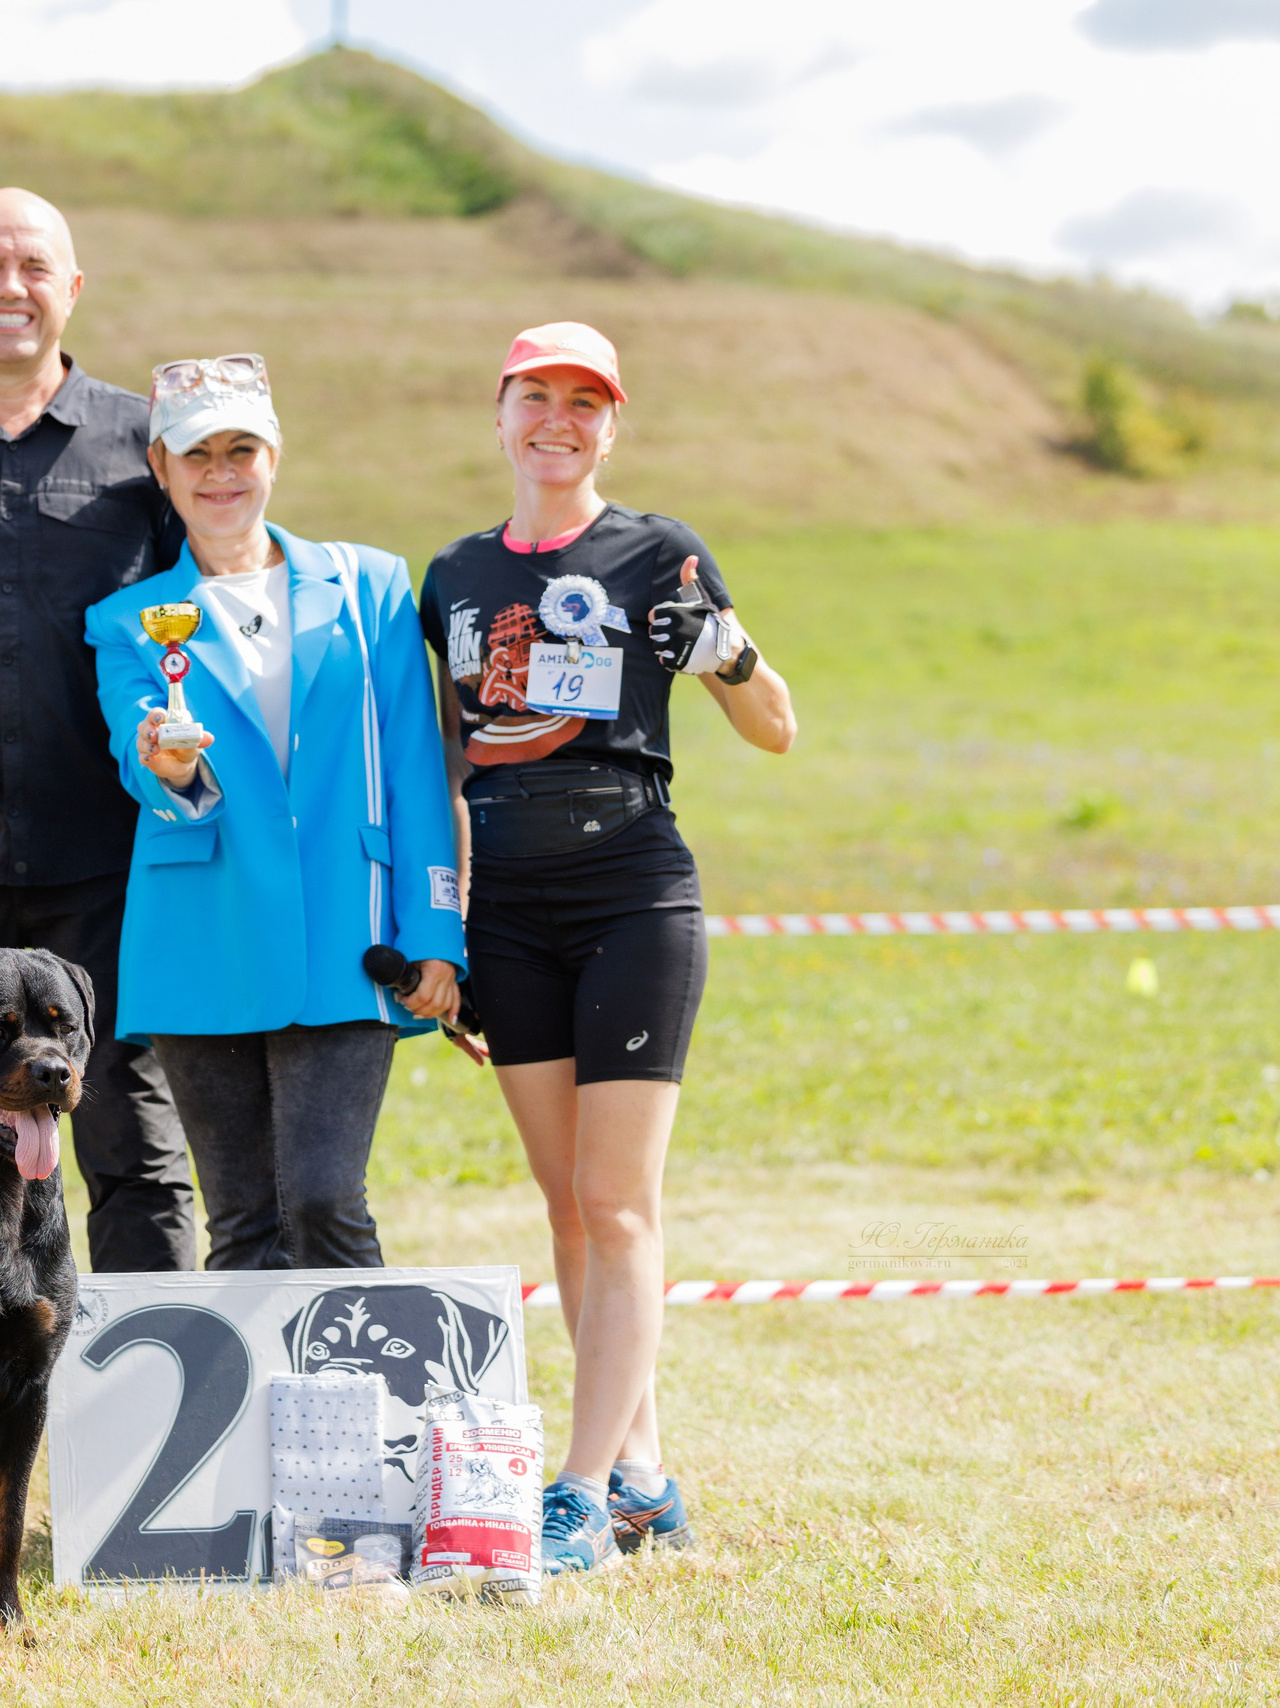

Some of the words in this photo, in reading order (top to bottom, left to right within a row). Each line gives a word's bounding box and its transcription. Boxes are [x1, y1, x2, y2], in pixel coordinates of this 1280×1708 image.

[449, 607, 481, 639] WE
[447, 631, 482, 669] RUN
[552, 671, 584, 702] 19
[81, 1303, 257, 1585] 2
[432, 1428, 444, 1464] ЛАЙН
[463, 1427, 521, 1439] ЗООМЕНЮ
[449, 1454, 463, 1463] 25
[483, 1443, 532, 1457] УНИВЕРСАЛ
[449, 1468, 462, 1477] 12
[430, 1467, 444, 1519] БРИДЕР
